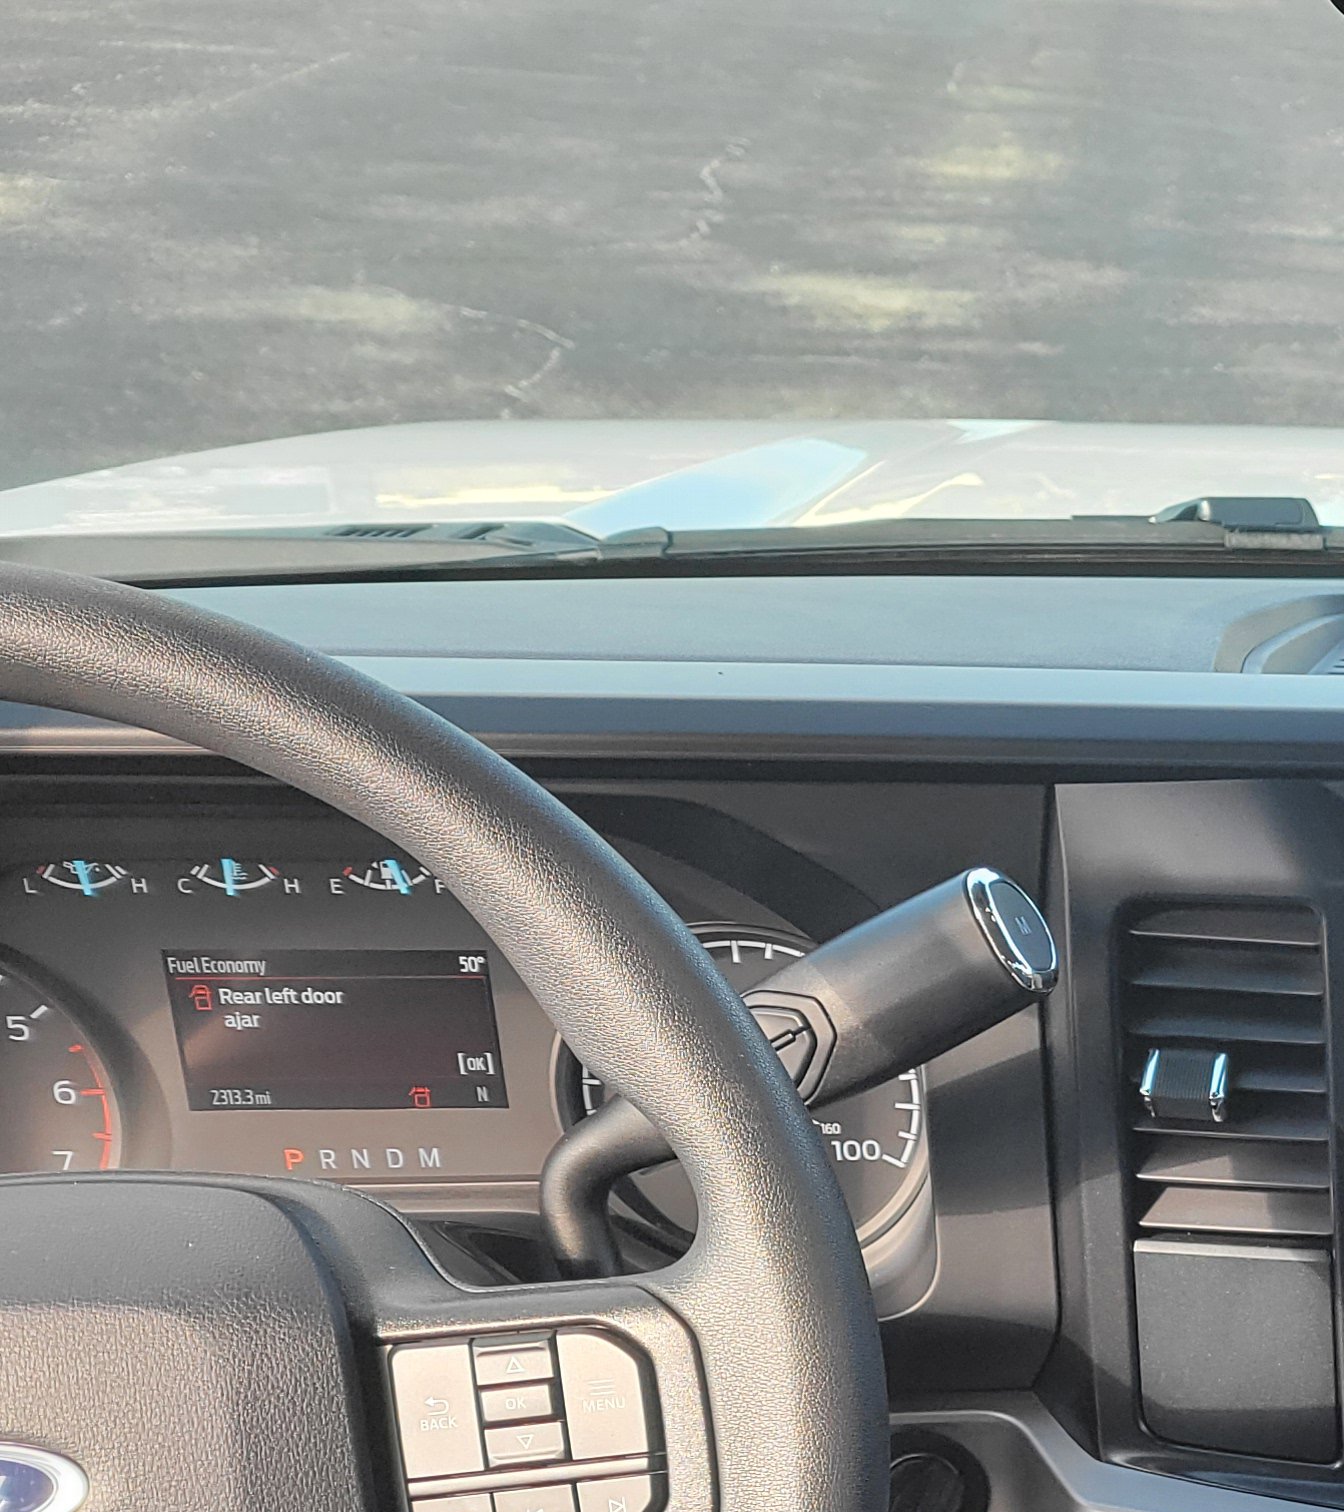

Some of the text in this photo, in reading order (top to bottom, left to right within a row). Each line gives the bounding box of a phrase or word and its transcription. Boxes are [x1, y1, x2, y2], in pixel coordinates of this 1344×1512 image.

[23, 879, 37, 894] L
[132, 879, 148, 894] H
[178, 879, 193, 894] C
[284, 879, 301, 894] H
[330, 879, 344, 894] E
[167, 957, 267, 976] Fuel Economy
[219, 987, 345, 1005] Rear left door
[6, 1016, 30, 1041] 5
[224, 1013, 261, 1030] ajar
[53, 1080, 77, 1104] 6
[477, 1087, 489, 1102] N
[820, 1122, 841, 1134] 160
[831, 1140, 881, 1161] 100
[52, 1150, 74, 1170] 7
[505, 1397, 526, 1410] OK
[582, 1397, 625, 1413] MENU
[420, 1416, 458, 1431] BACK
